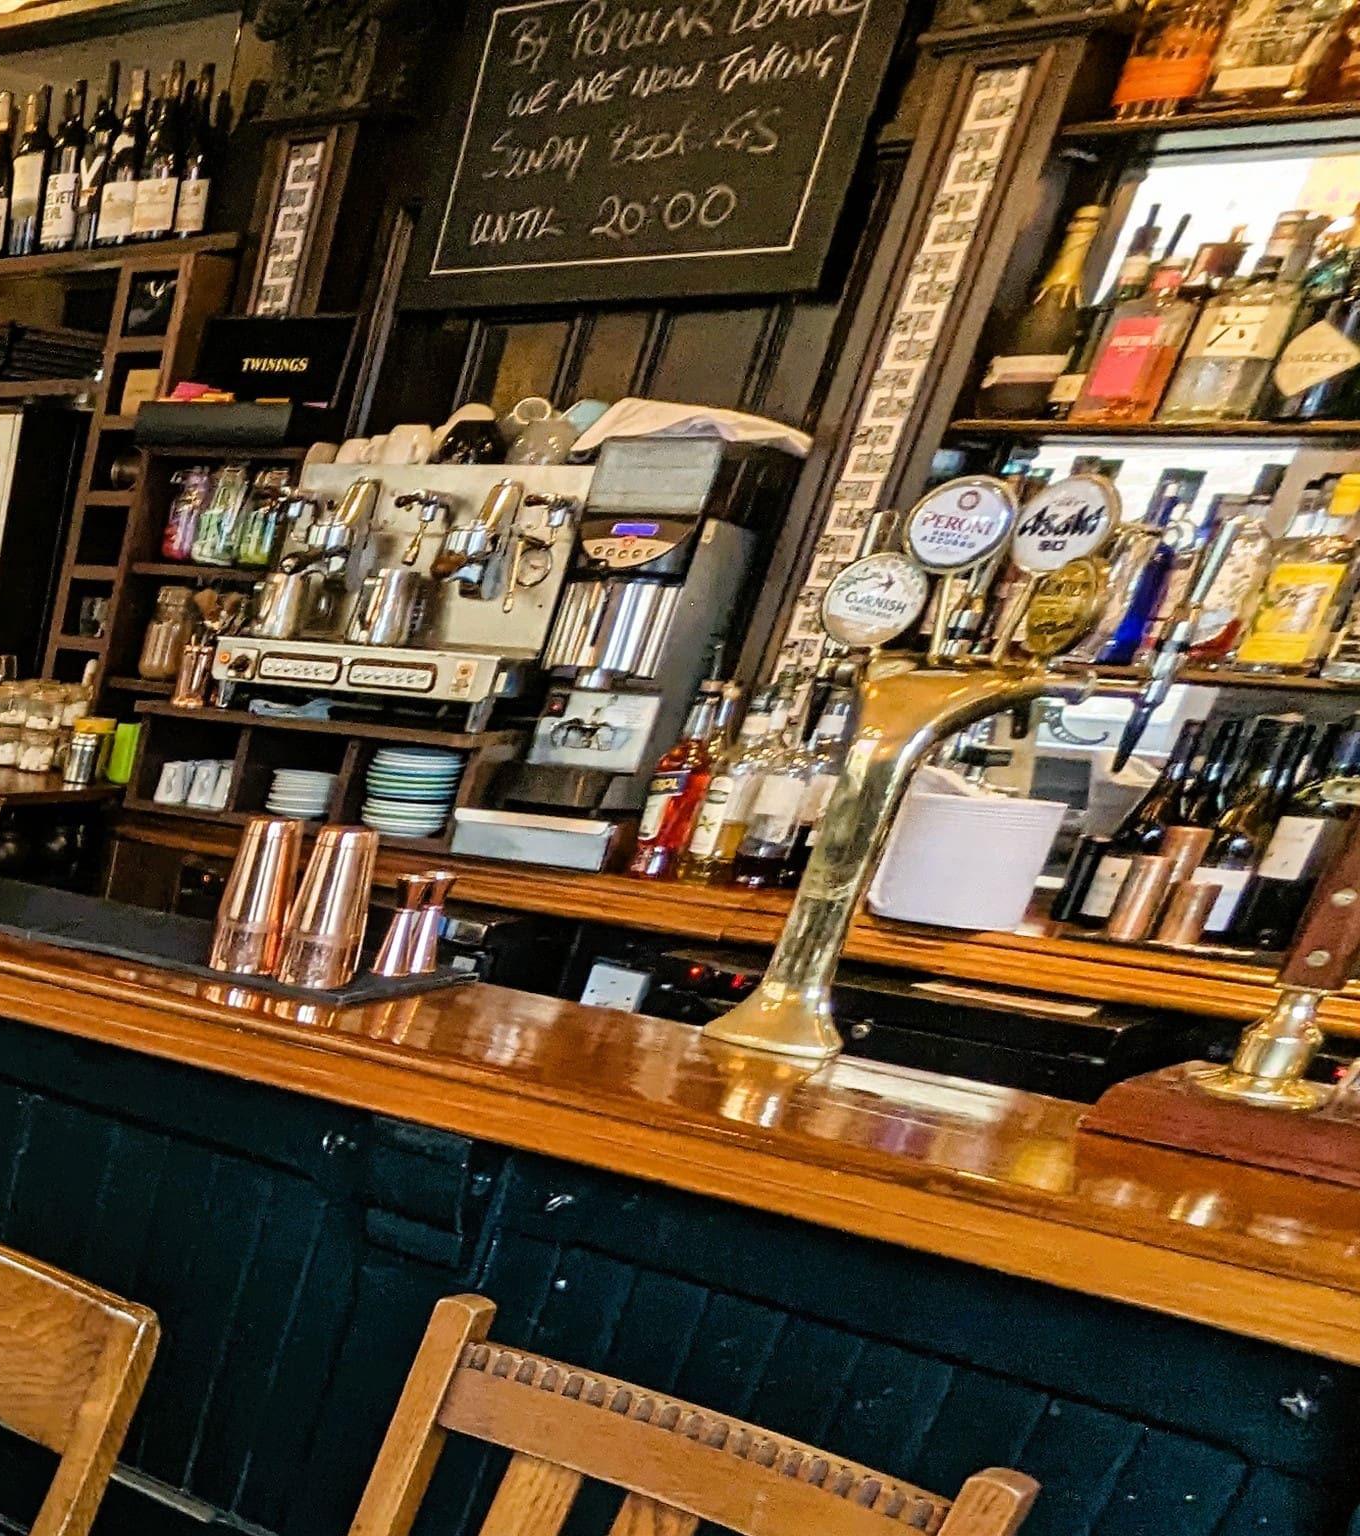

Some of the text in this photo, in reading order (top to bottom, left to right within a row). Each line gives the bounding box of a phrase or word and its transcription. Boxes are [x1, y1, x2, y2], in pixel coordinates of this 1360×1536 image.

[557, 65, 633, 112] ARE
[632, 62, 706, 98] NOW
[718, 34, 843, 94] TAKING
[470, 206, 566, 246] UNTIL
[241, 357, 309, 373] TWININGS
[921, 510, 997, 537] PERONI
[1018, 504, 1106, 537] Asahi
[844, 590, 908, 615] CORNISH
